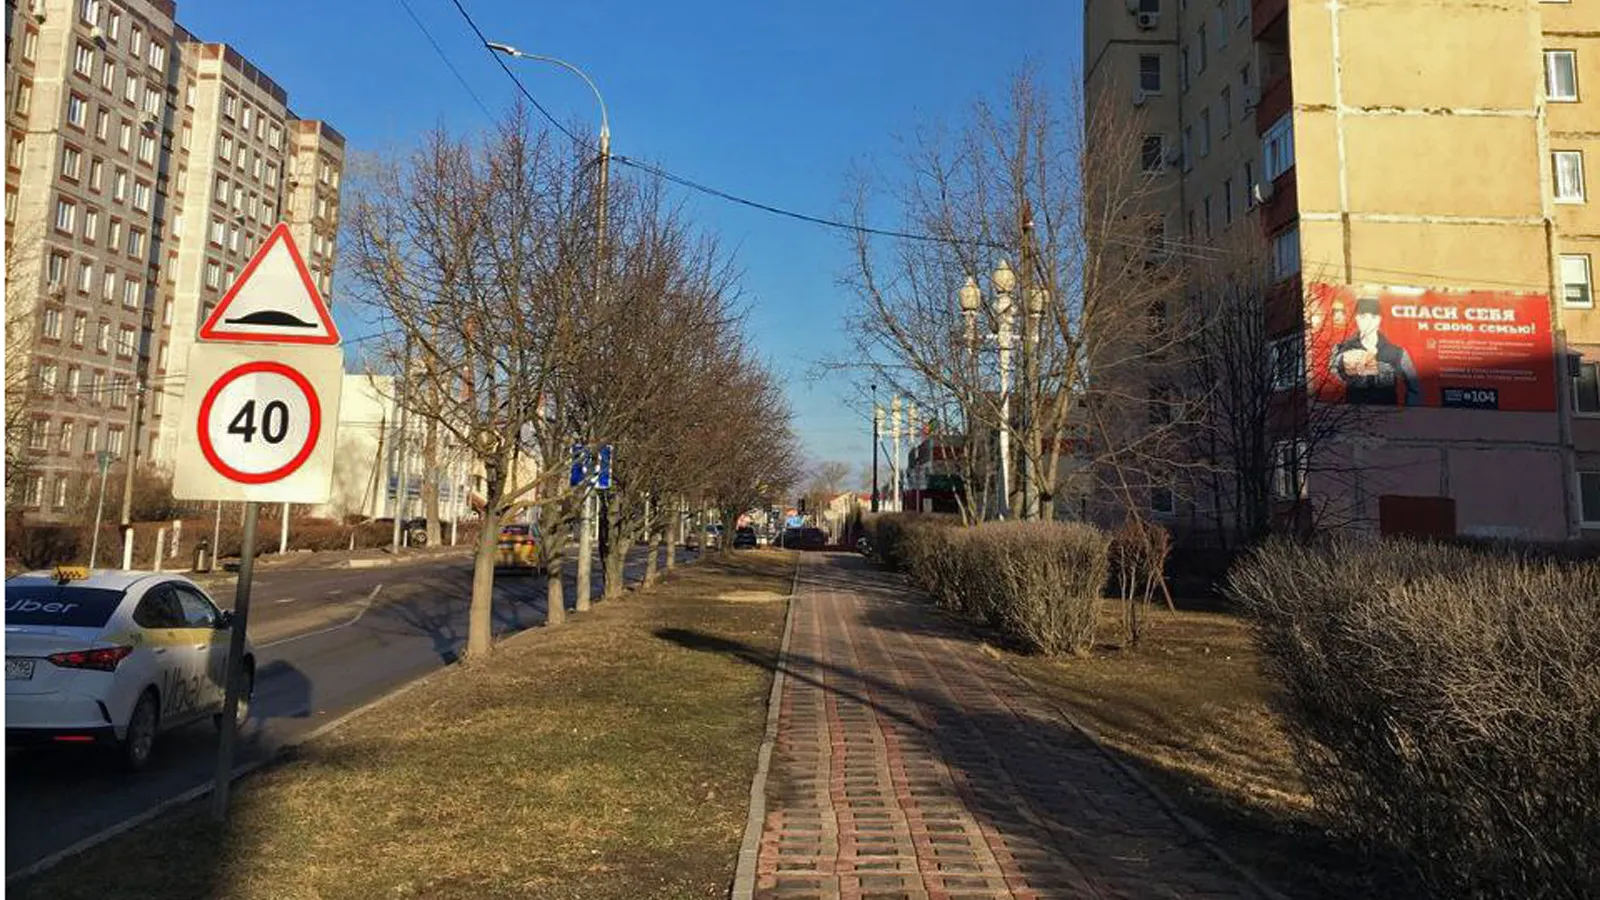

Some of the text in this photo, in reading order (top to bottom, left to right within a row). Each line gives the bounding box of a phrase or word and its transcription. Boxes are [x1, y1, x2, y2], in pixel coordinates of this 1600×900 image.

[1391, 305, 1515, 321] СПАСИ СЕБЯ
[1471, 390, 1496, 403] 104
[227, 400, 289, 444] 40
